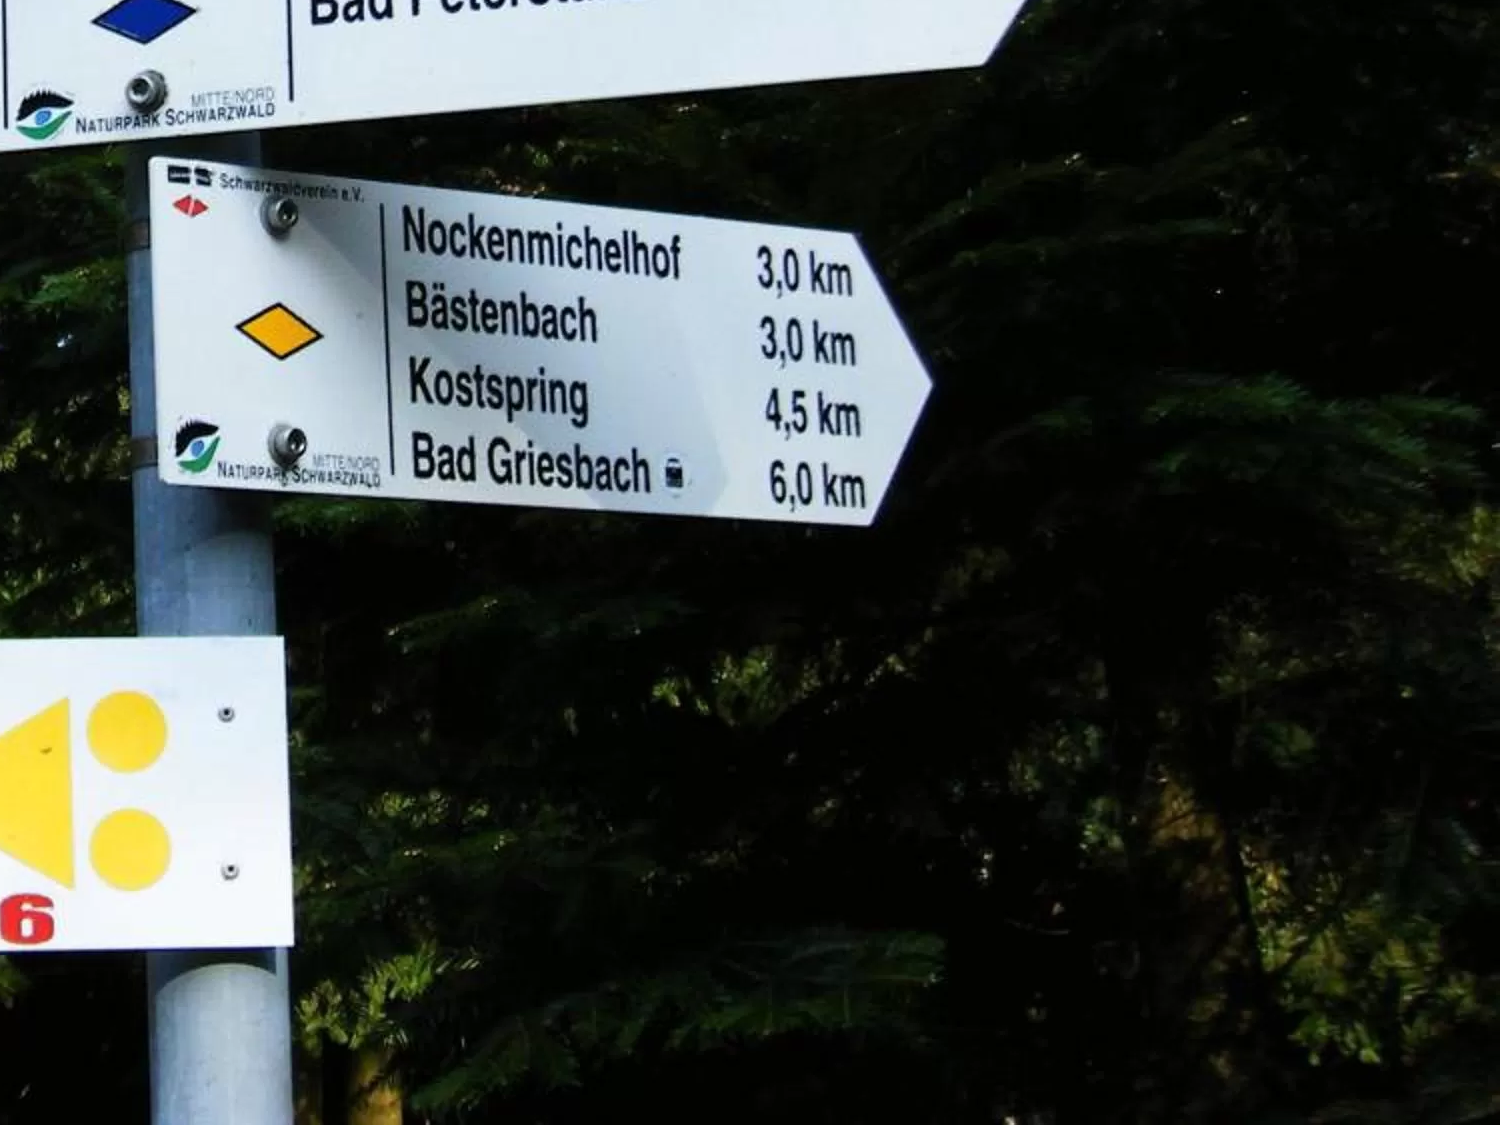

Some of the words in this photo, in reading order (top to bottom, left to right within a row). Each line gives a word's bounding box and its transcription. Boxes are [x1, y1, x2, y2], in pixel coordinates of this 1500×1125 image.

[76, 113, 160, 134] NATURPARK
[165, 103, 275, 126] SCHWARZWALD
[219, 173, 338, 199] Schwarzwaldverein
[403, 206, 680, 280] Nockenmichelhof
[758, 246, 799, 298] 3,0
[810, 251, 852, 296] km
[406, 281, 597, 343] Bästenbach
[760, 316, 803, 368] 3,0
[813, 320, 856, 366] km
[409, 356, 588, 429] Kostspring
[766, 388, 808, 440] 4,5
[818, 391, 861, 437] km
[412, 431, 476, 481] Bad
[488, 437, 650, 492] Griesbach
[770, 460, 812, 510] 6,0
[823, 463, 866, 508] km
